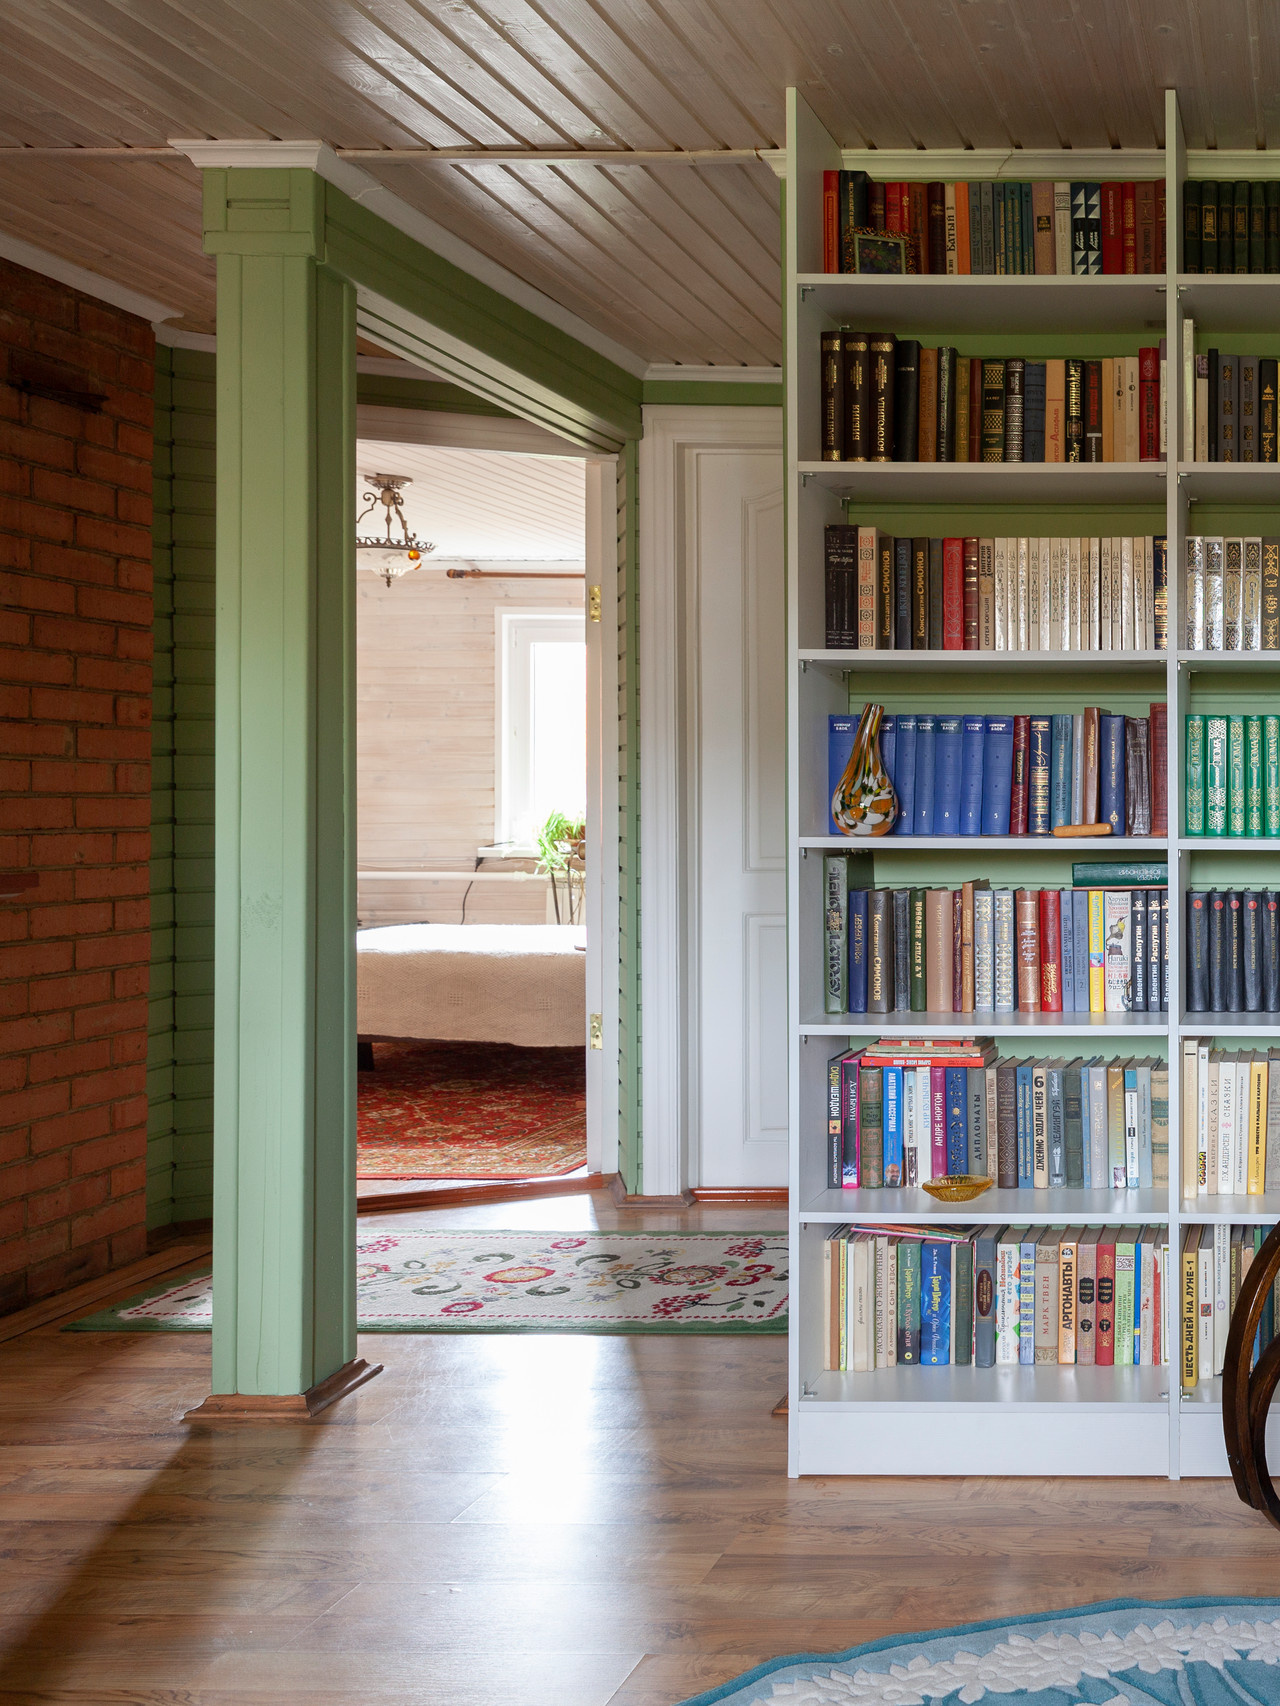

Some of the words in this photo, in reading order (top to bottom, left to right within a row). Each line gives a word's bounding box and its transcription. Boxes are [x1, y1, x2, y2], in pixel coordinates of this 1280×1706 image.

[946, 215, 955, 251] Батый
[827, 398, 835, 445] ЕВАНГЕЛИЕ
[1145, 385, 1154, 429] СТАДНЮК
[917, 595, 925, 637] Константин
[914, 901, 922, 939] ЗВЕРОБОЙ
[1135, 925, 1144, 962] Распутин
[1151, 925, 1159, 962] Распутин
[1135, 964, 1143, 1002] Валентин
[830, 1087, 840, 1117] ШЕЛДОН
[888, 1072, 897, 1099] АНАТОЛИЙ
[922, 1075, 930, 1111] БУЛЫЧЕВ
[1035, 1091, 1043, 1111] ЧЕЙЗ
[888, 1100, 897, 1132] ВАССЕРМАН
[934, 1093, 943, 1121] НОРТОН
[1052, 1099, 1062, 1144] ХЕМИНГУЭЙ
[1210, 1078, 1218, 1132] СКАЗКИ
[935, 1123, 944, 1146] АНДРЕ
[973, 1094, 982, 1160] ДИПЛОМАТЫ
[1035, 1112, 1044, 1138] ХЭДЛИ
[1035, 1139, 1044, 1171] ДЖЕЙМС
[1222, 1133, 1231, 1169] АНДЕРСЕН
[876, 1247, 884, 1298] ЖИВОТНЫХ
[1063, 1262, 1073, 1330] АРГОНАВТЫ
[1185, 1301, 1194, 1314] НА
[1185, 1316, 1194, 1343] ДНЕЙ
[1185, 1345, 1194, 1378] ШЕСТЬ
